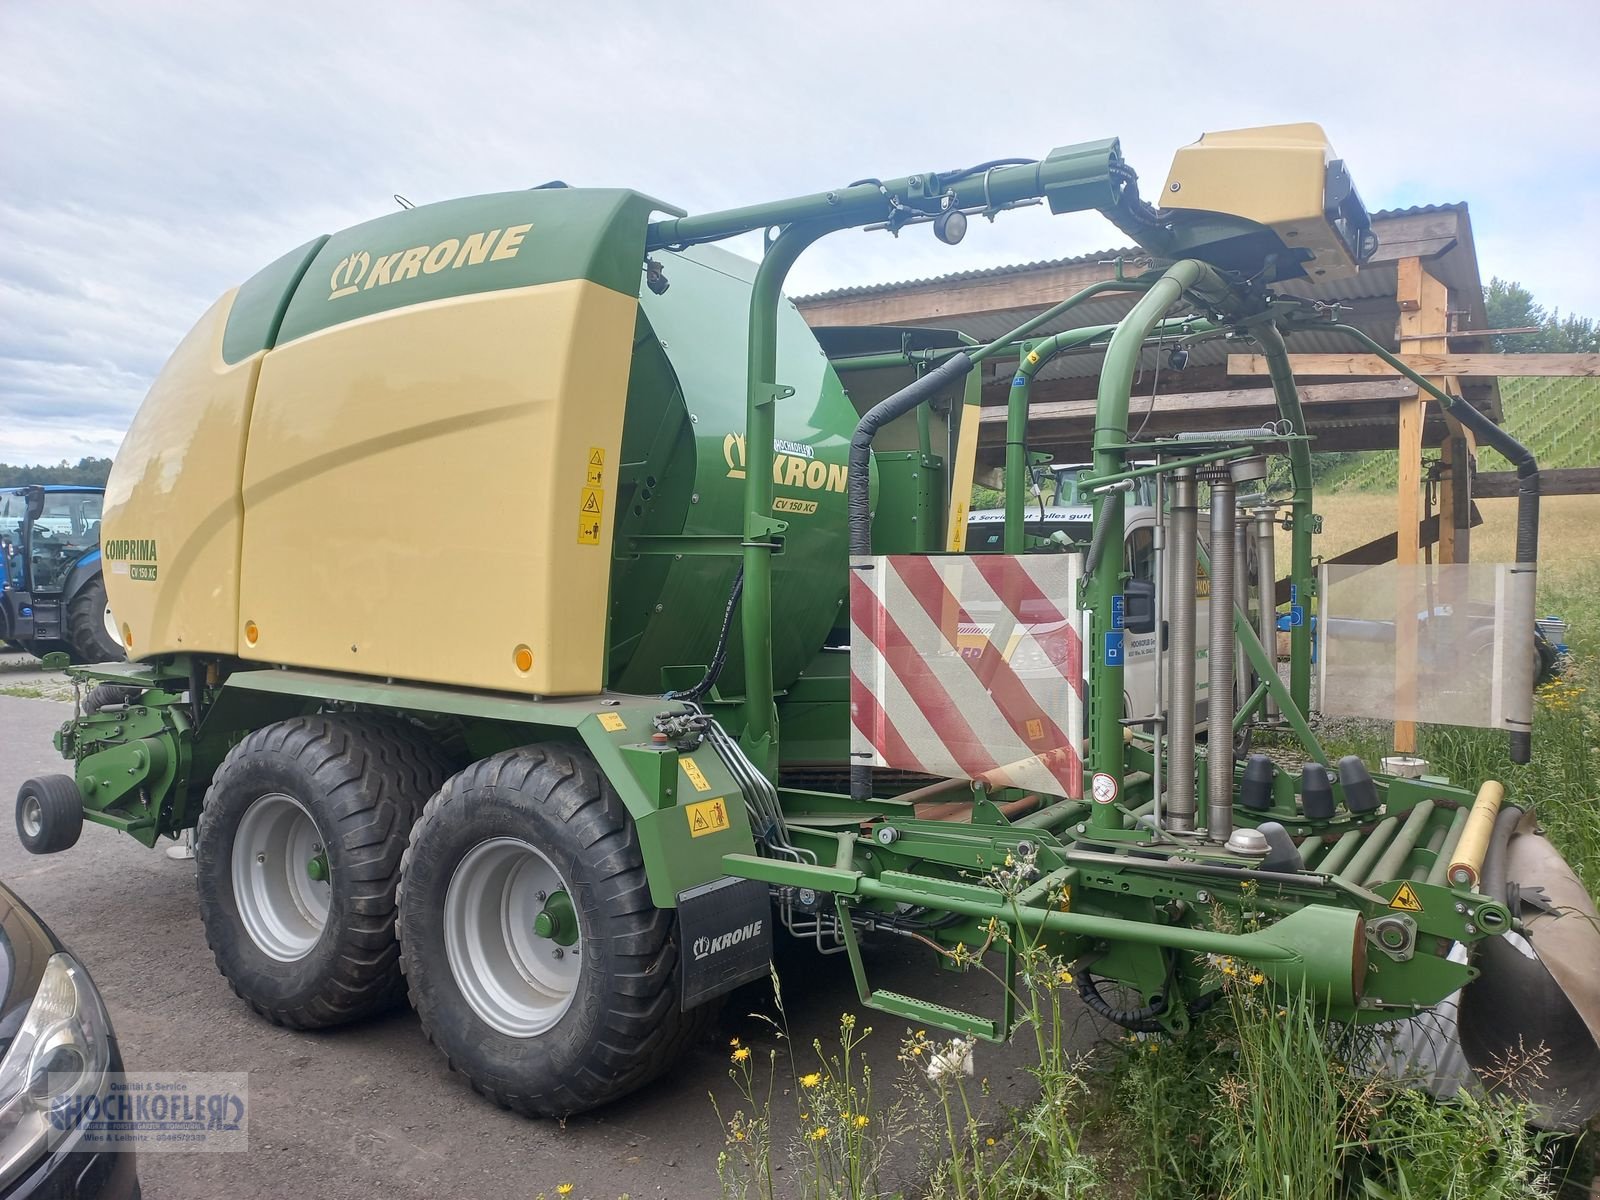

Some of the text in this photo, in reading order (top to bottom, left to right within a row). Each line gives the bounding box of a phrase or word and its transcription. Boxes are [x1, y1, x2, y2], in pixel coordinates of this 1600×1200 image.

[363, 223, 534, 290] KRONE
[772, 454, 849, 494] KRON
[775, 500, 815, 512] CV 150 XC
[105, 540, 157, 561] COMPRIMA
[131, 567, 156, 579] CV 150 XC
[710, 920, 762, 954] KRONE
